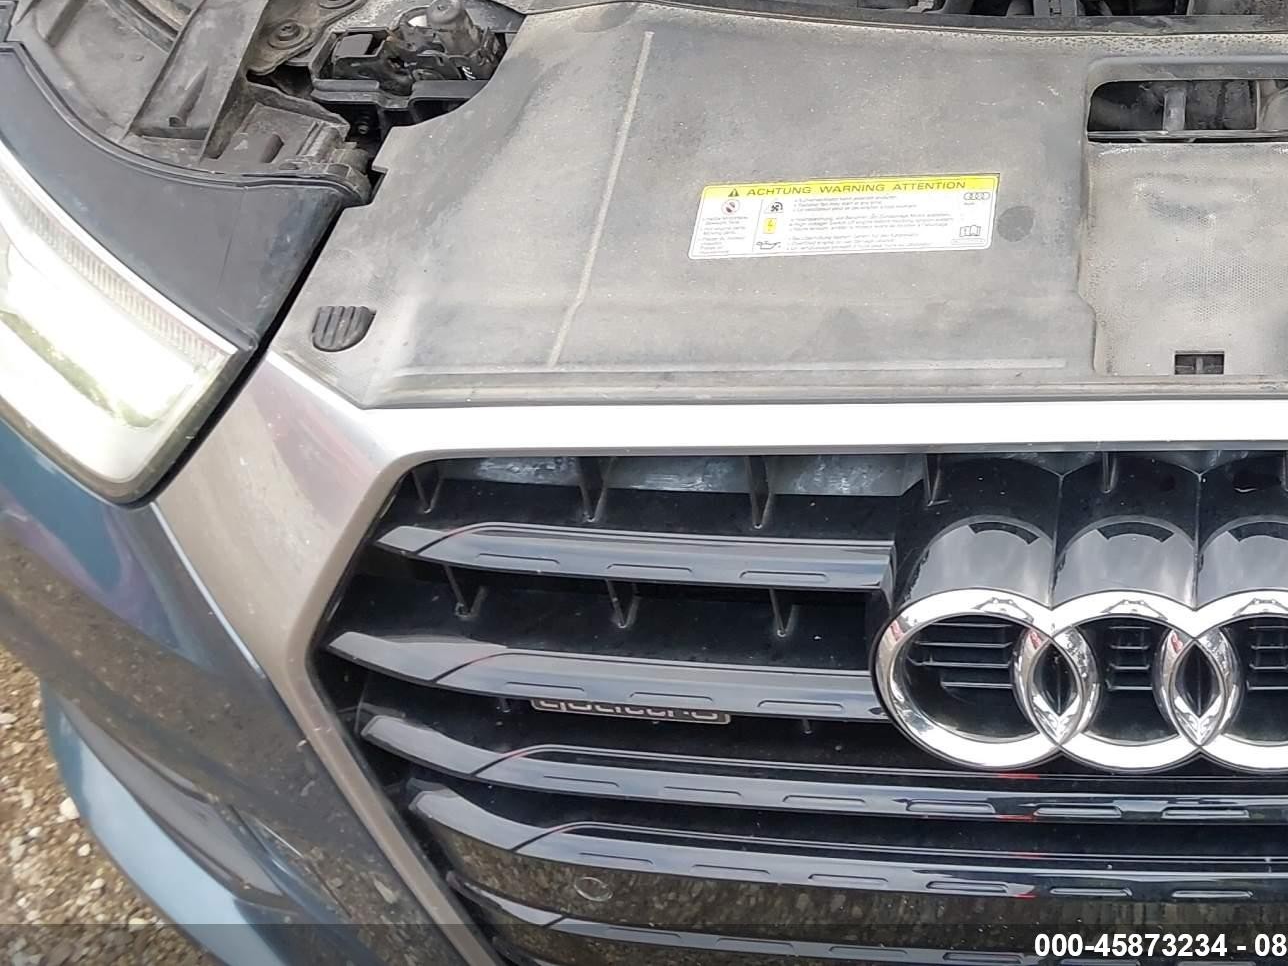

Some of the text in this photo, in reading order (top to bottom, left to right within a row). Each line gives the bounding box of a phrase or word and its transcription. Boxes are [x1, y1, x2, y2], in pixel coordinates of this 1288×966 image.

[747, 181, 966, 196] ACHTUNG WARNING ATTENTION
